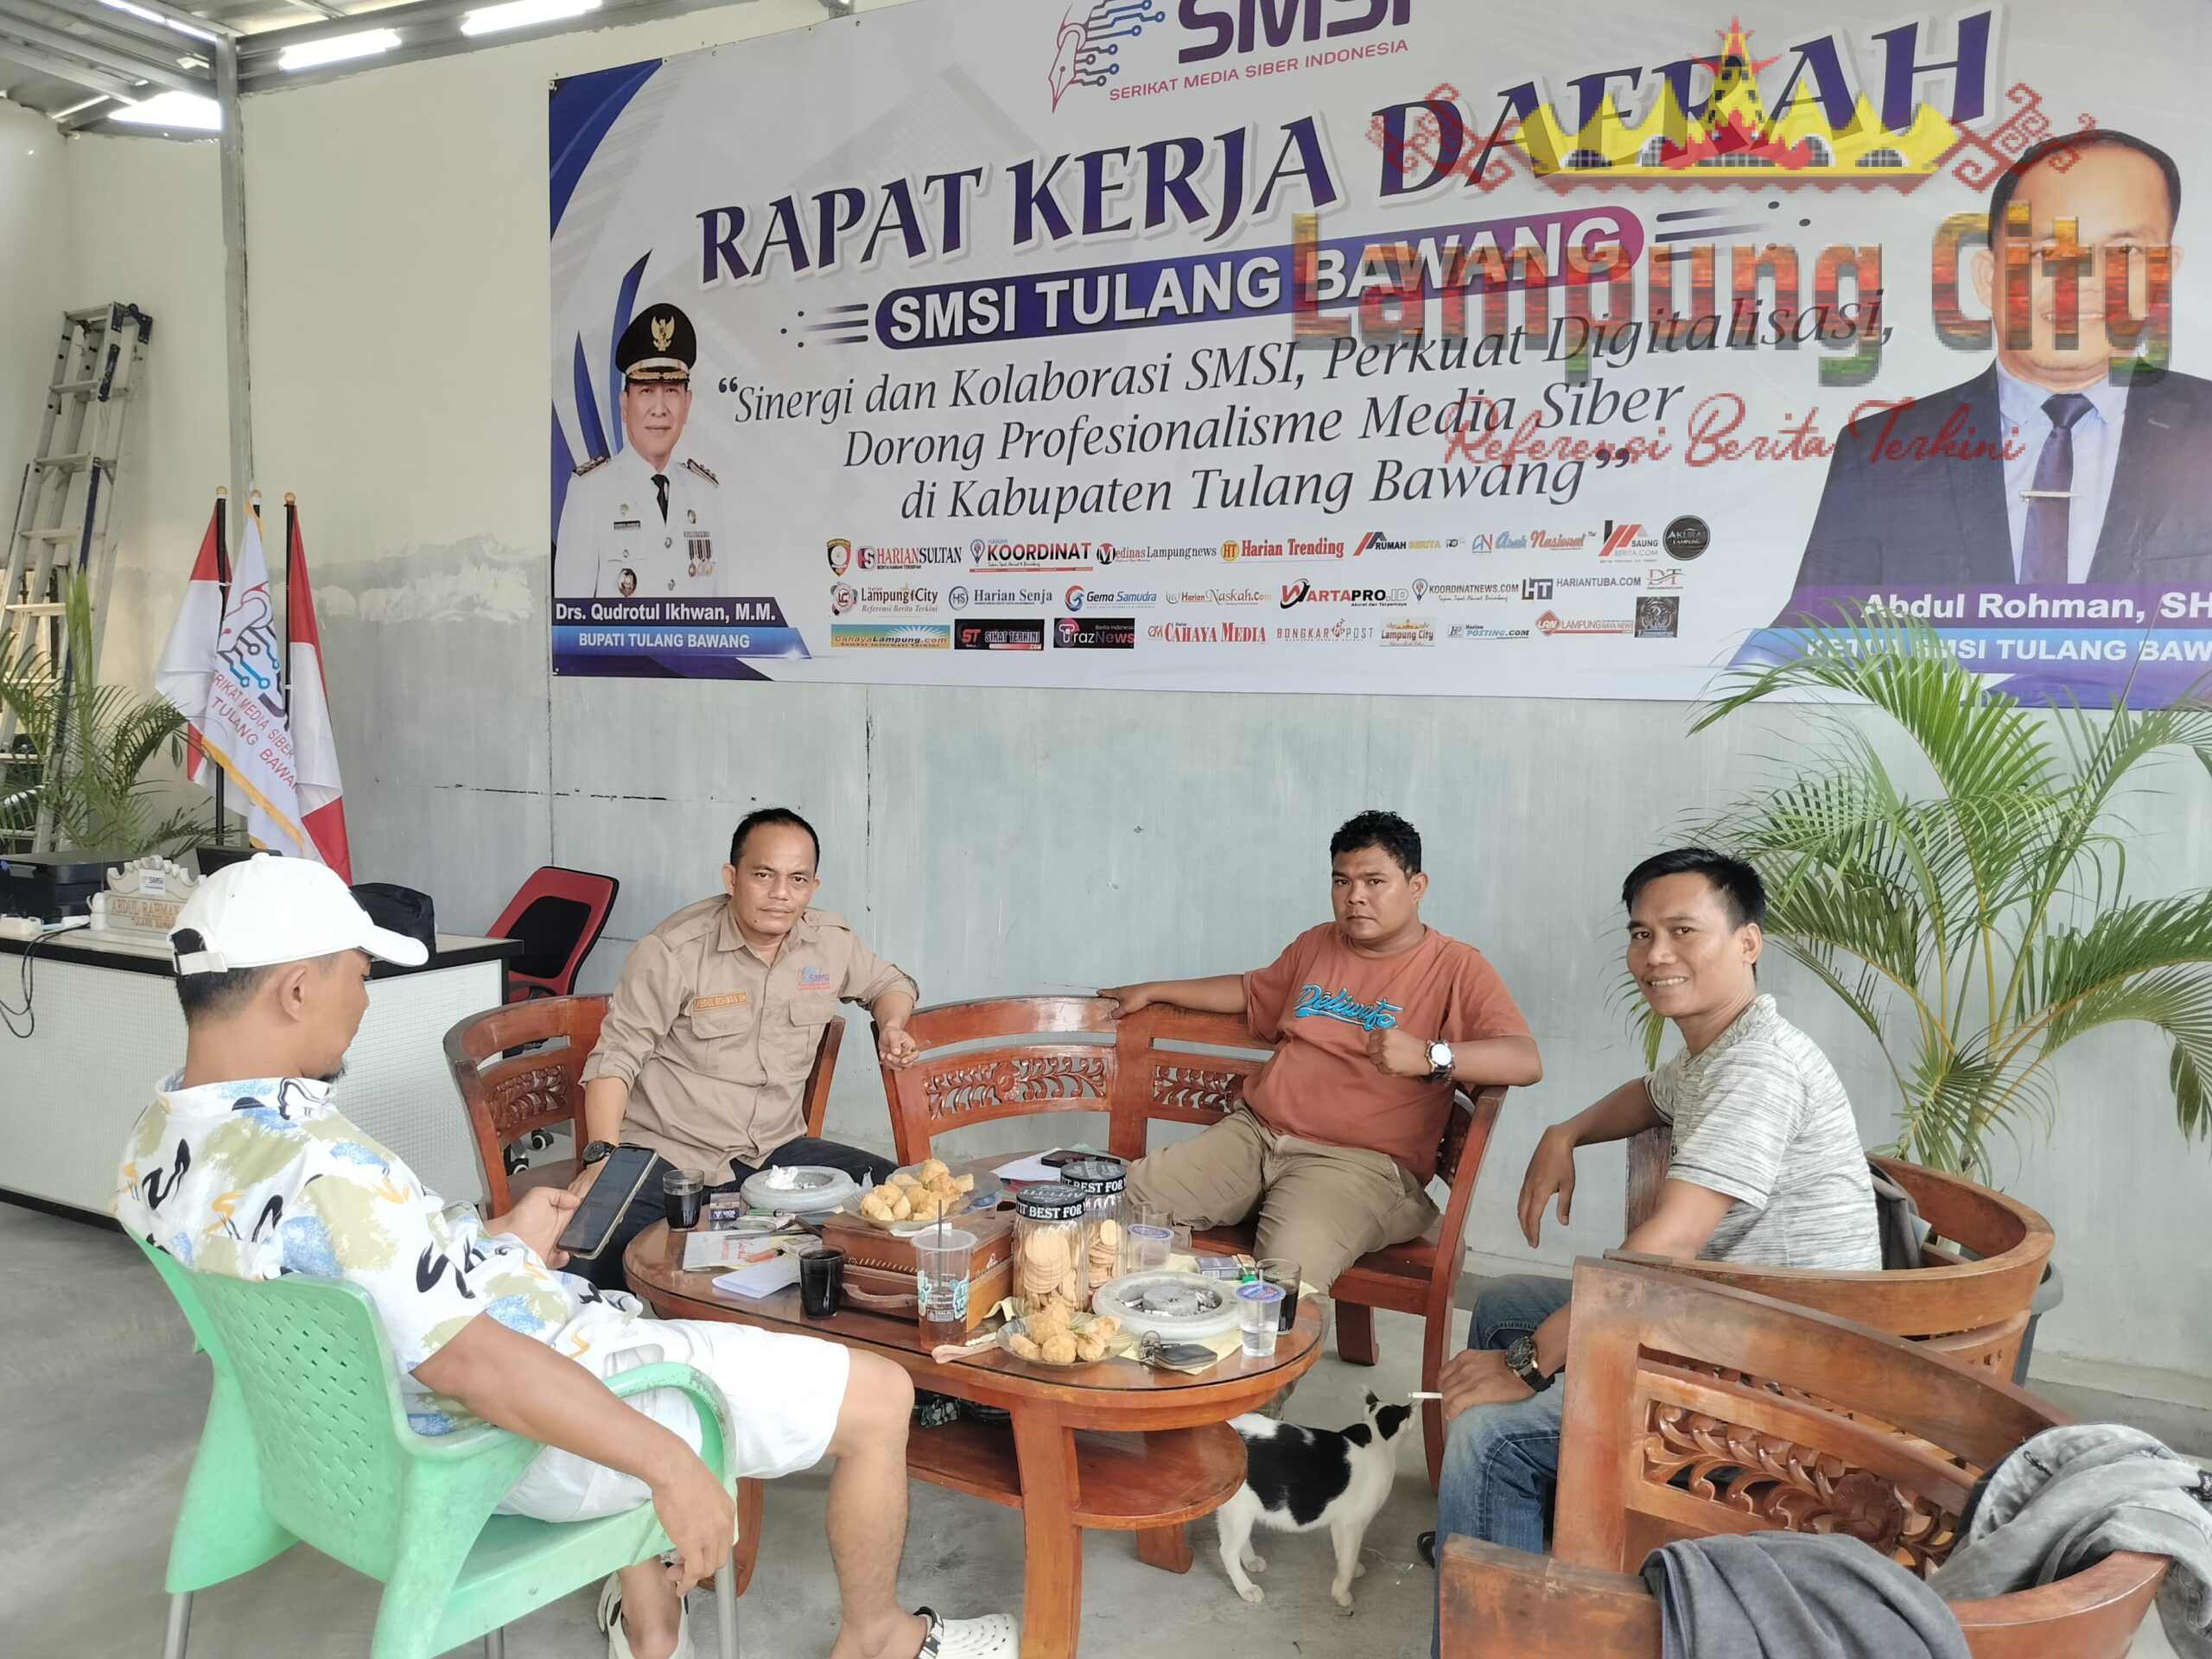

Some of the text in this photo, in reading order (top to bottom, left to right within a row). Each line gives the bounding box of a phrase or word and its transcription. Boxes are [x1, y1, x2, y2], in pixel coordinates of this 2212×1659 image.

[1109, 39, 1408, 101] SERIKAT MEDIA SIBER INDONESIA
[696, 10, 1992, 283] RAPAT KERJA DAERAH
[890, 216, 1621, 343] SMSI TULANG BAWANG
[865, 373, 937, 412] dan
[949, 352, 1173, 407] Kolaborasi
[1185, 340, 1304, 391] SMSI,
[1322, 324, 1529, 380] Perkuat
[1542, 289, 1893, 369] Digitalisasi,
[843, 378, 1685, 471] Dorong Profesionalisme Media Siber
[901, 480, 938, 519] di
[948, 477, 1172, 524] Kabupaten
[1191, 463, 1355, 515] Tulang
[988, 543, 1091, 561] KOORDINAT
[1242, 537, 1344, 558] Harian Trending
[1376, 541, 1406, 550] RUMAH
[1430, 583, 1519, 594] KOORDINATNEWS.COM
[1556, 577, 1641, 588] HARIANTUBA.COM
[861, 588, 939, 604] Lampung City
[975, 588, 1052, 604] Harian Senja
[1087, 591, 1157, 602] Gema Samudra
[556, 603, 776, 624] Drs. Qudrotul Ikhwan, M.M.
[1860, 594, 1965, 619] Abdul
[1979, 593, 2145, 623] Rohman,
[579, 633, 750, 648] BUPATI TULANG BAWANG
[1165, 622, 1266, 643] CAHAYA MEDIA
[1277, 627, 1374, 639] BONGKAR POST
[1382, 629, 1433, 641] Lampung City
[1998, 639, 2126, 661] TULANG
[239, 698, 270, 730] MEDIA
[212, 696, 297, 790] TULANG BAWA
[1105, 1179, 1122, 1192] FOR
[1029, 1206, 1060, 1219] BEST
[1063, 1204, 1082, 1217] FOR
